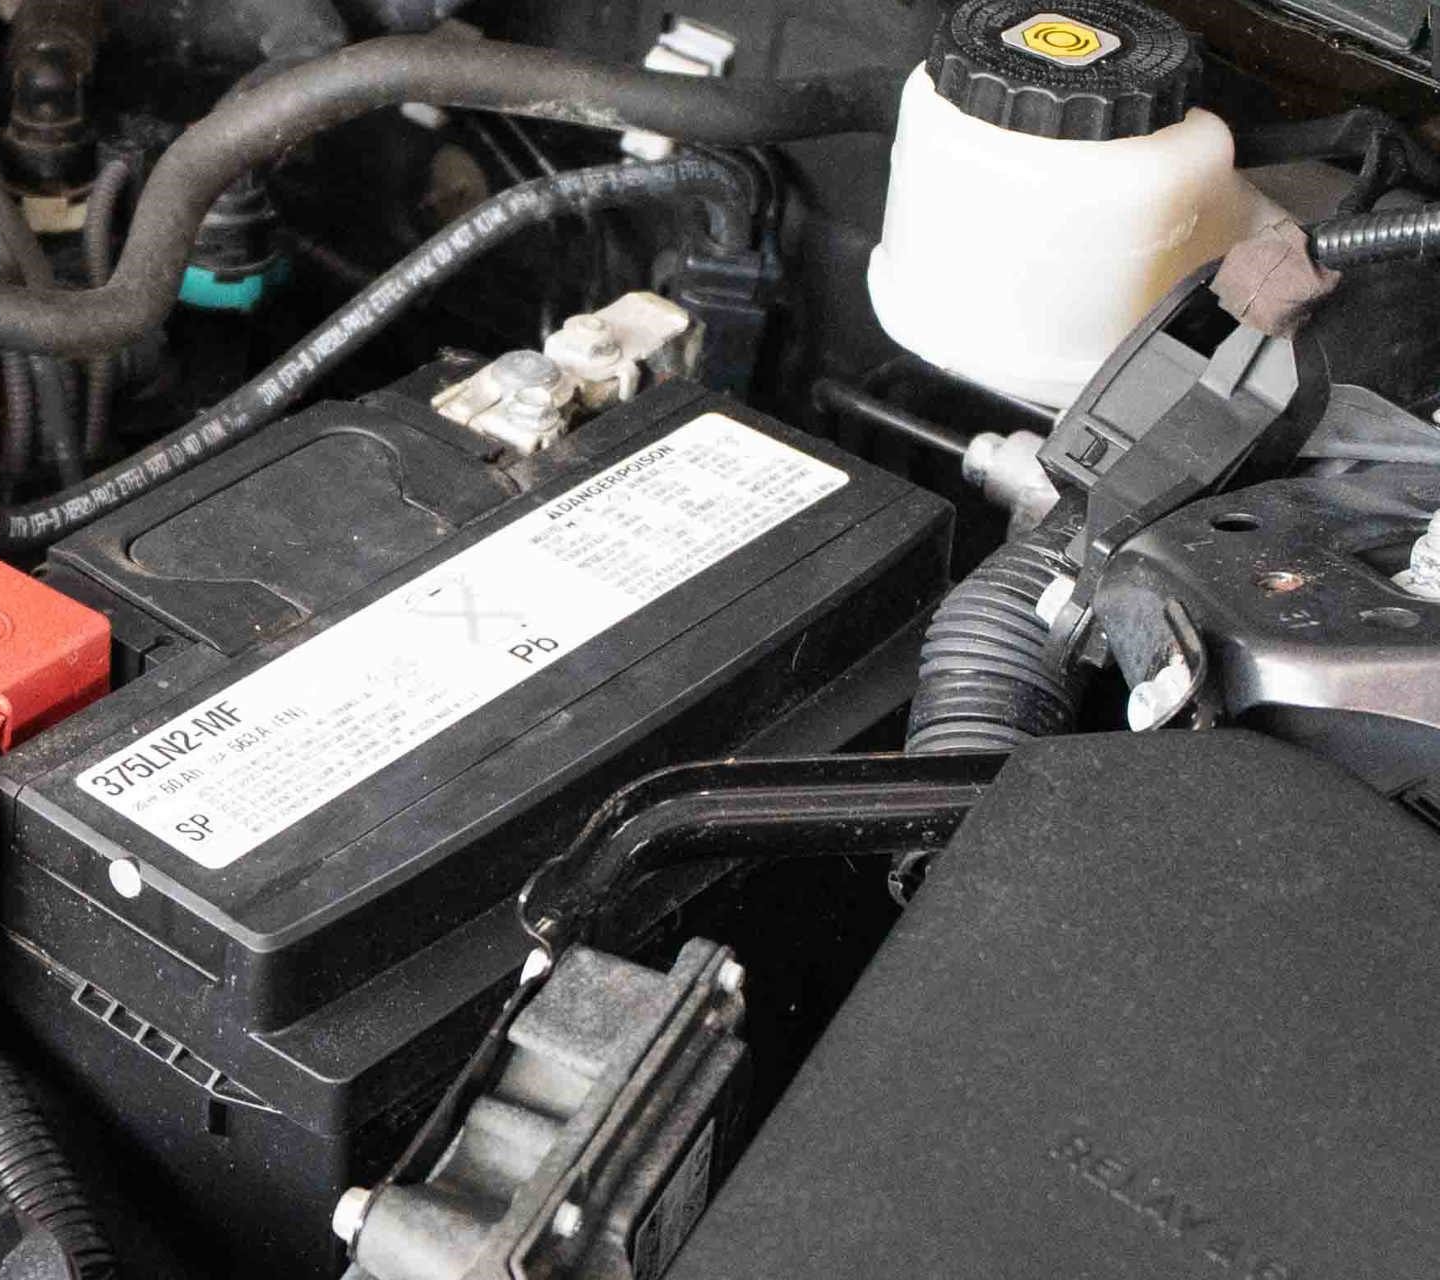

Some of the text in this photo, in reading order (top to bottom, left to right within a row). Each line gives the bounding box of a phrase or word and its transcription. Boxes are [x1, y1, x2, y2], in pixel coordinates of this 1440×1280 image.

[508, 637, 558, 663] Pb
[91, 701, 241, 796] 375LN2-MF
[175, 813, 214, 841] SP
